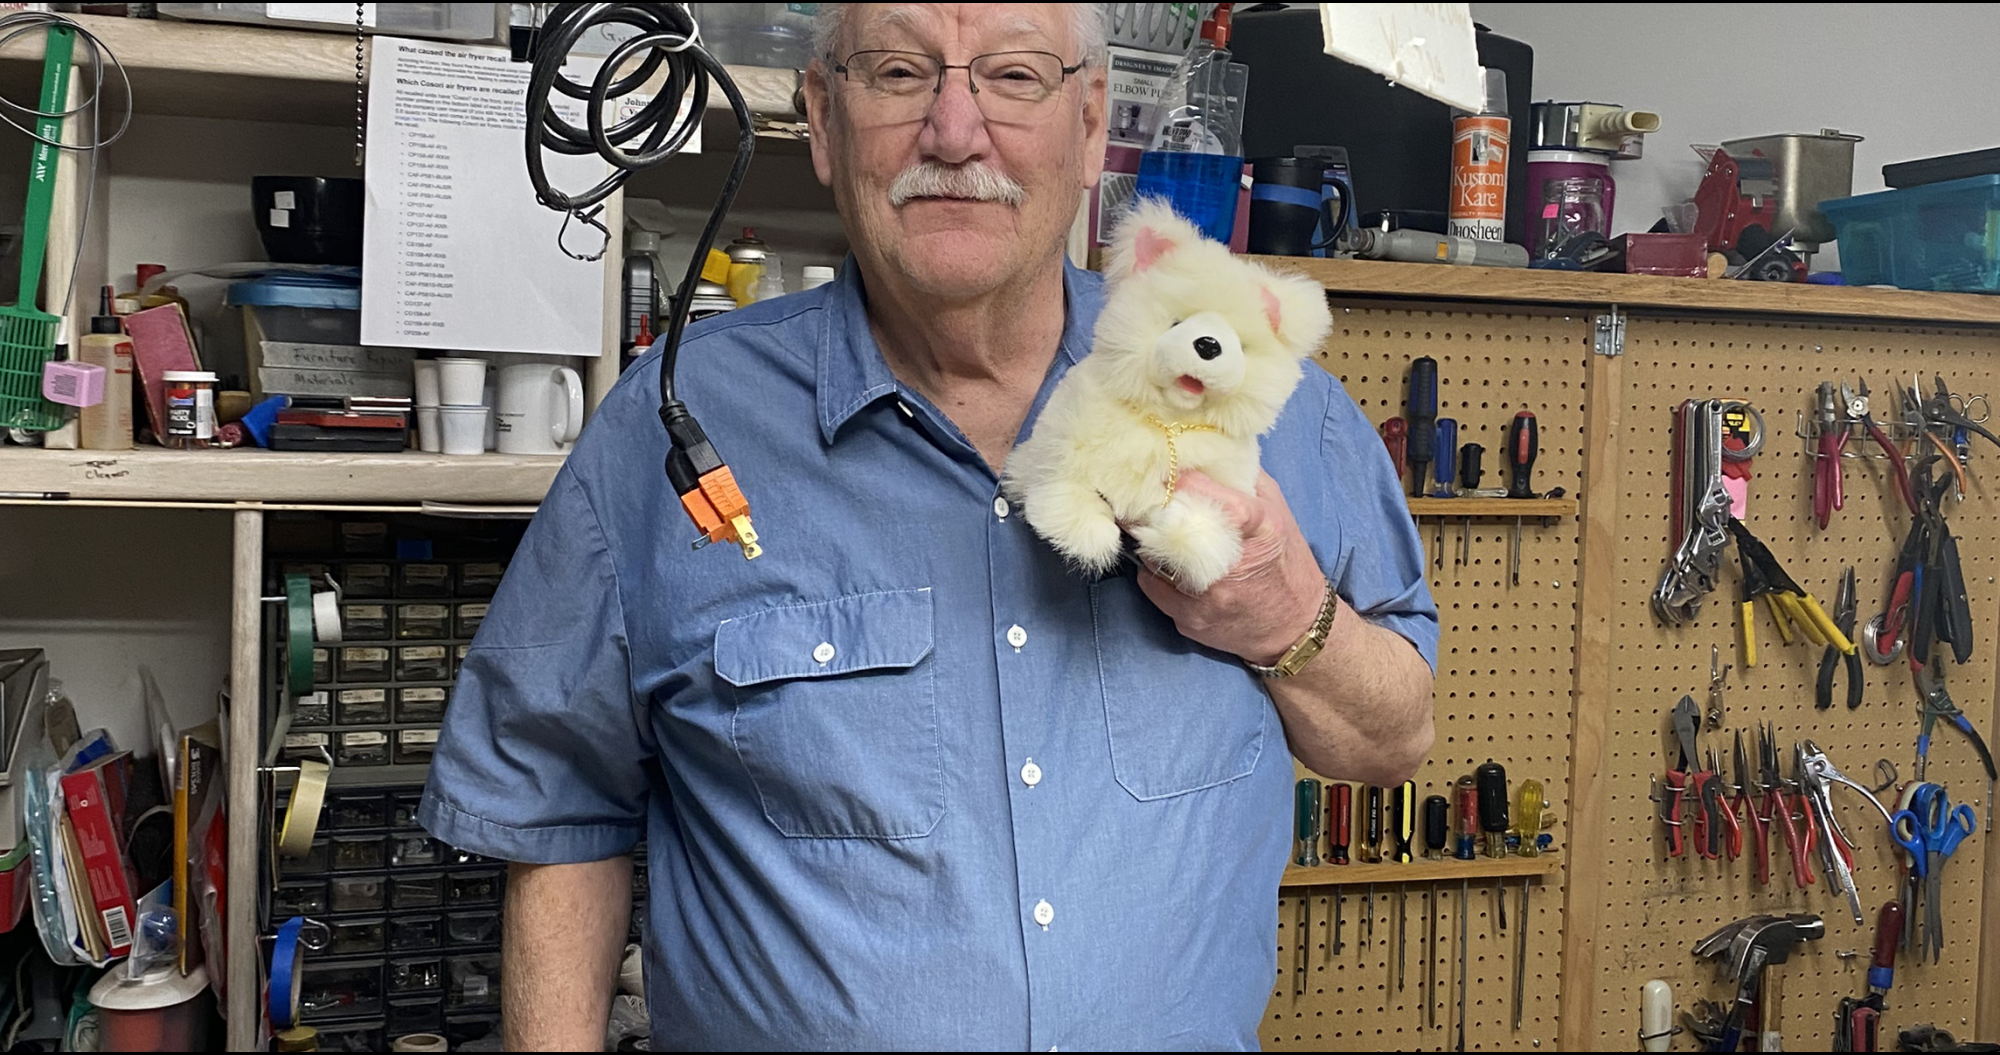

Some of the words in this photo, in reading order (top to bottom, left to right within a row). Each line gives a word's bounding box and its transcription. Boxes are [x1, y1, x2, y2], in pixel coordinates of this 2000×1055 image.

[398, 45, 416, 53] What
[418, 47, 443, 56] caused
[468, 52, 485, 60] fryer
[486, 54, 506, 62] recall
[396, 77, 418, 85] Which
[420, 79, 444, 88] Cosori
[456, 83, 476, 91] fryers
[491, 86, 524, 96] recalled?
[1113, 83, 1149, 96] ELBOW
[1133, 78, 1154, 86] SMALL
[1454, 166, 1504, 186] Kustom
[1460, 184, 1497, 207] Kare
[293, 347, 358, 365] Furniture
[294, 373, 356, 386] Materials
